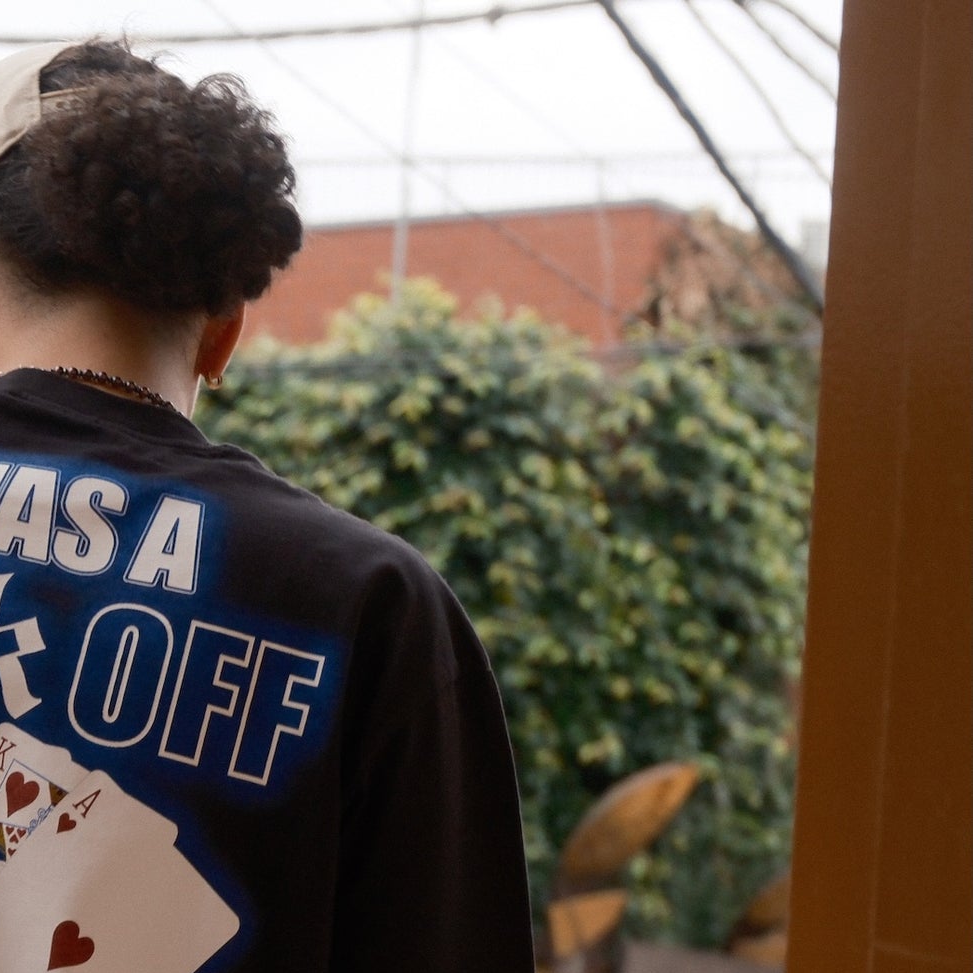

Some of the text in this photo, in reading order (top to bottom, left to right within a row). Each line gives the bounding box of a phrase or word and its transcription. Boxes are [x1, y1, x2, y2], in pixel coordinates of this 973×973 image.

[124, 494, 205, 594] A
[67, 602, 326, 787] OFF
[72, 788, 102, 819] A
